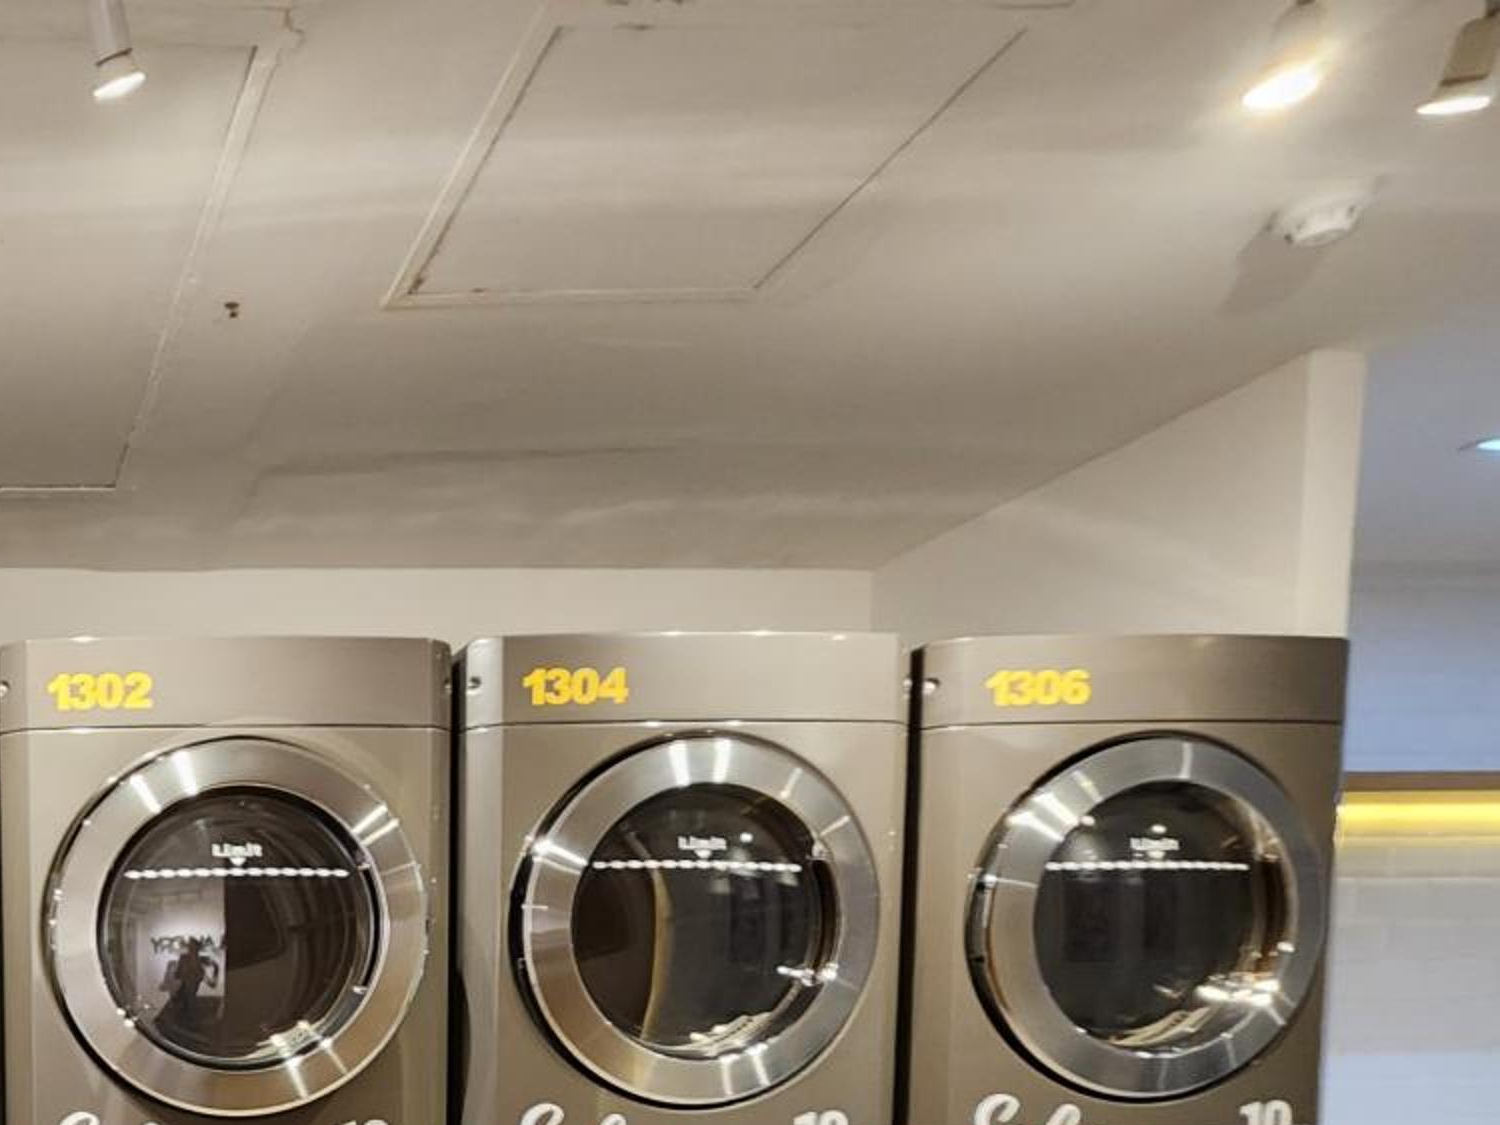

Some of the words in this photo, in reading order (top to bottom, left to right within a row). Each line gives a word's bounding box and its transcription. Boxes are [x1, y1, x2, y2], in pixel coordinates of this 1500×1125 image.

[48, 671, 152, 711] 1302
[523, 667, 628, 705] 1304
[985, 669, 1092, 706] 1306
